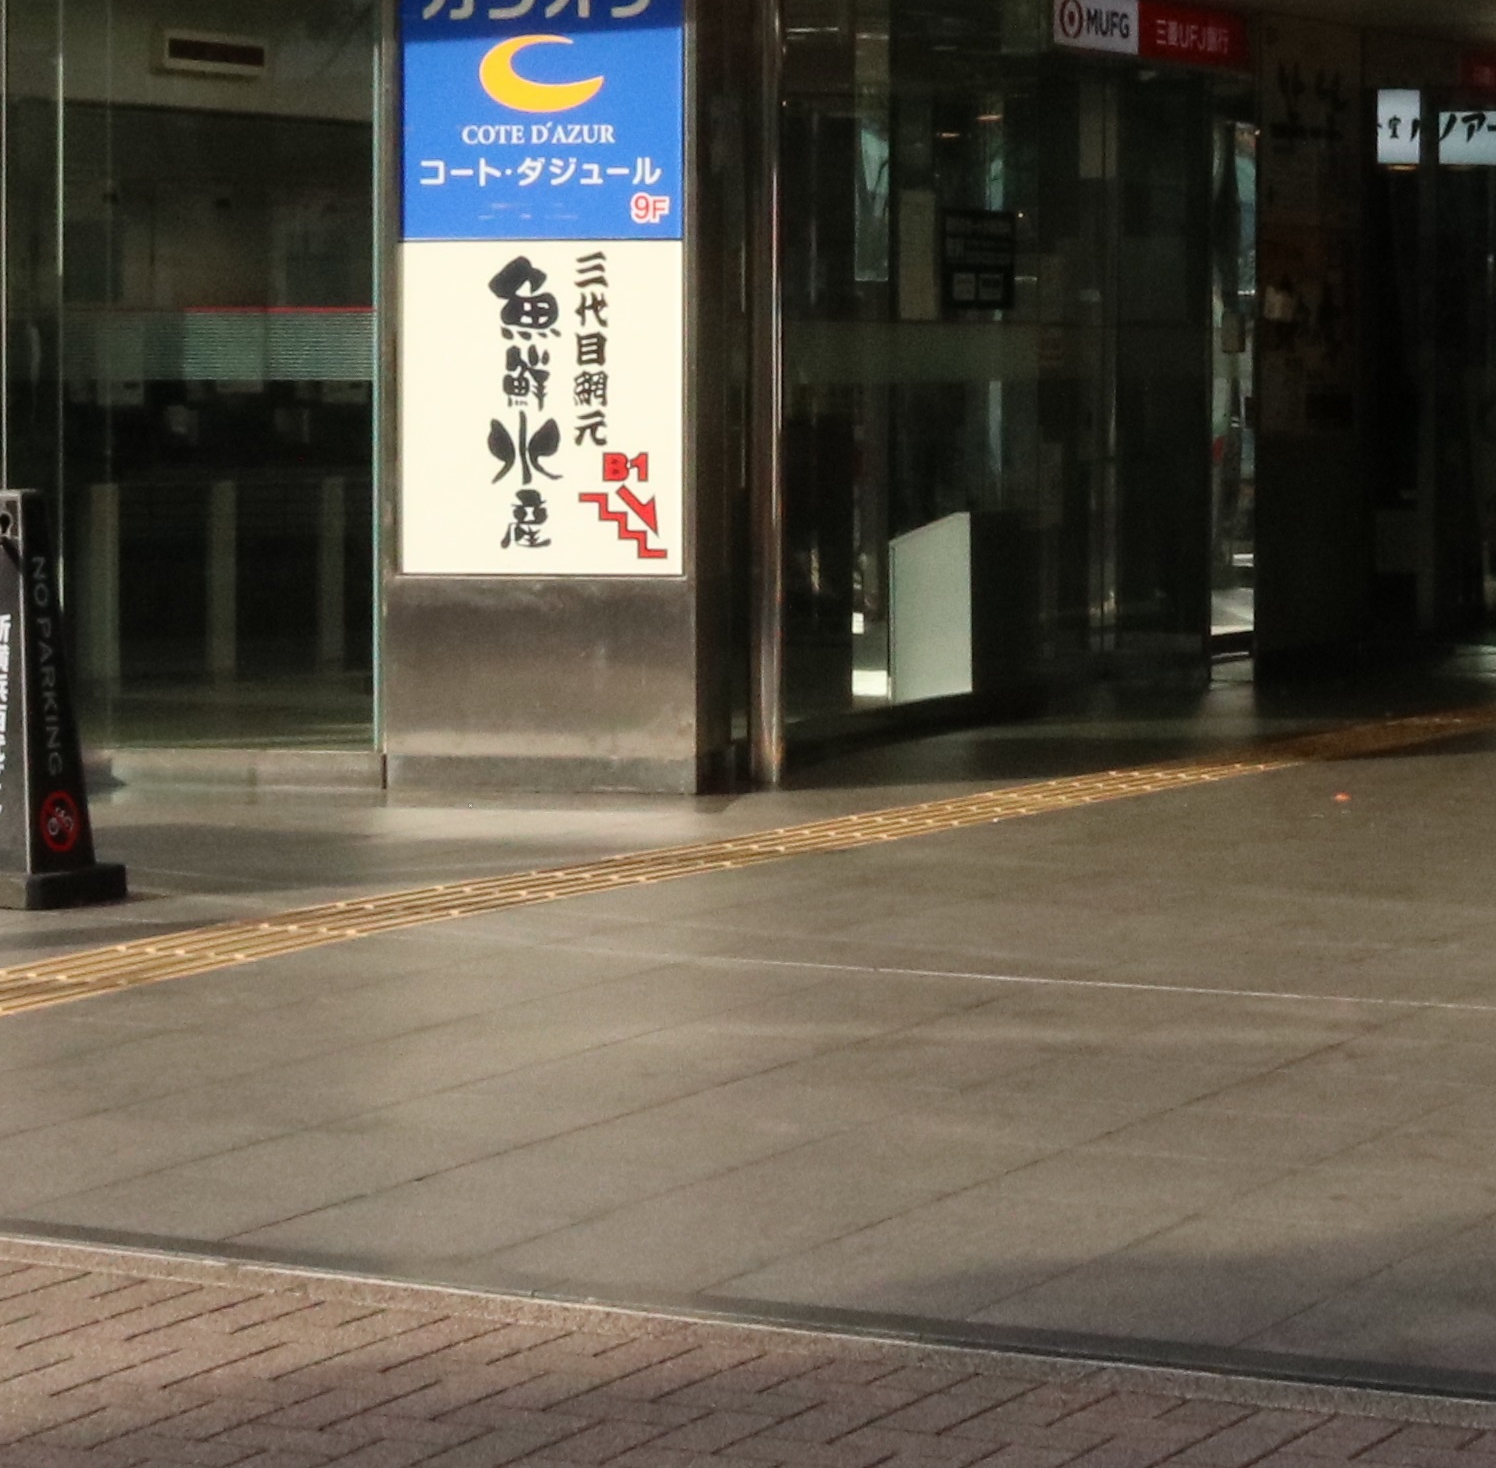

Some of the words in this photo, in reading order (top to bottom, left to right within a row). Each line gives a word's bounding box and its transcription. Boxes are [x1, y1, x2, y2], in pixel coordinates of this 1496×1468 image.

[1086, 8, 1130, 39] MUFG
[420, 157, 661, 186] コート・ダジュール
[631, 193, 670, 223] 9F
[574, 252, 608, 446] 三代目網元
[487, 256, 563, 549] 魚鮮水産
[602, 452, 648, 482] B1
[32, 557, 49, 608] NO
[37, 620, 63, 777] PARKING
